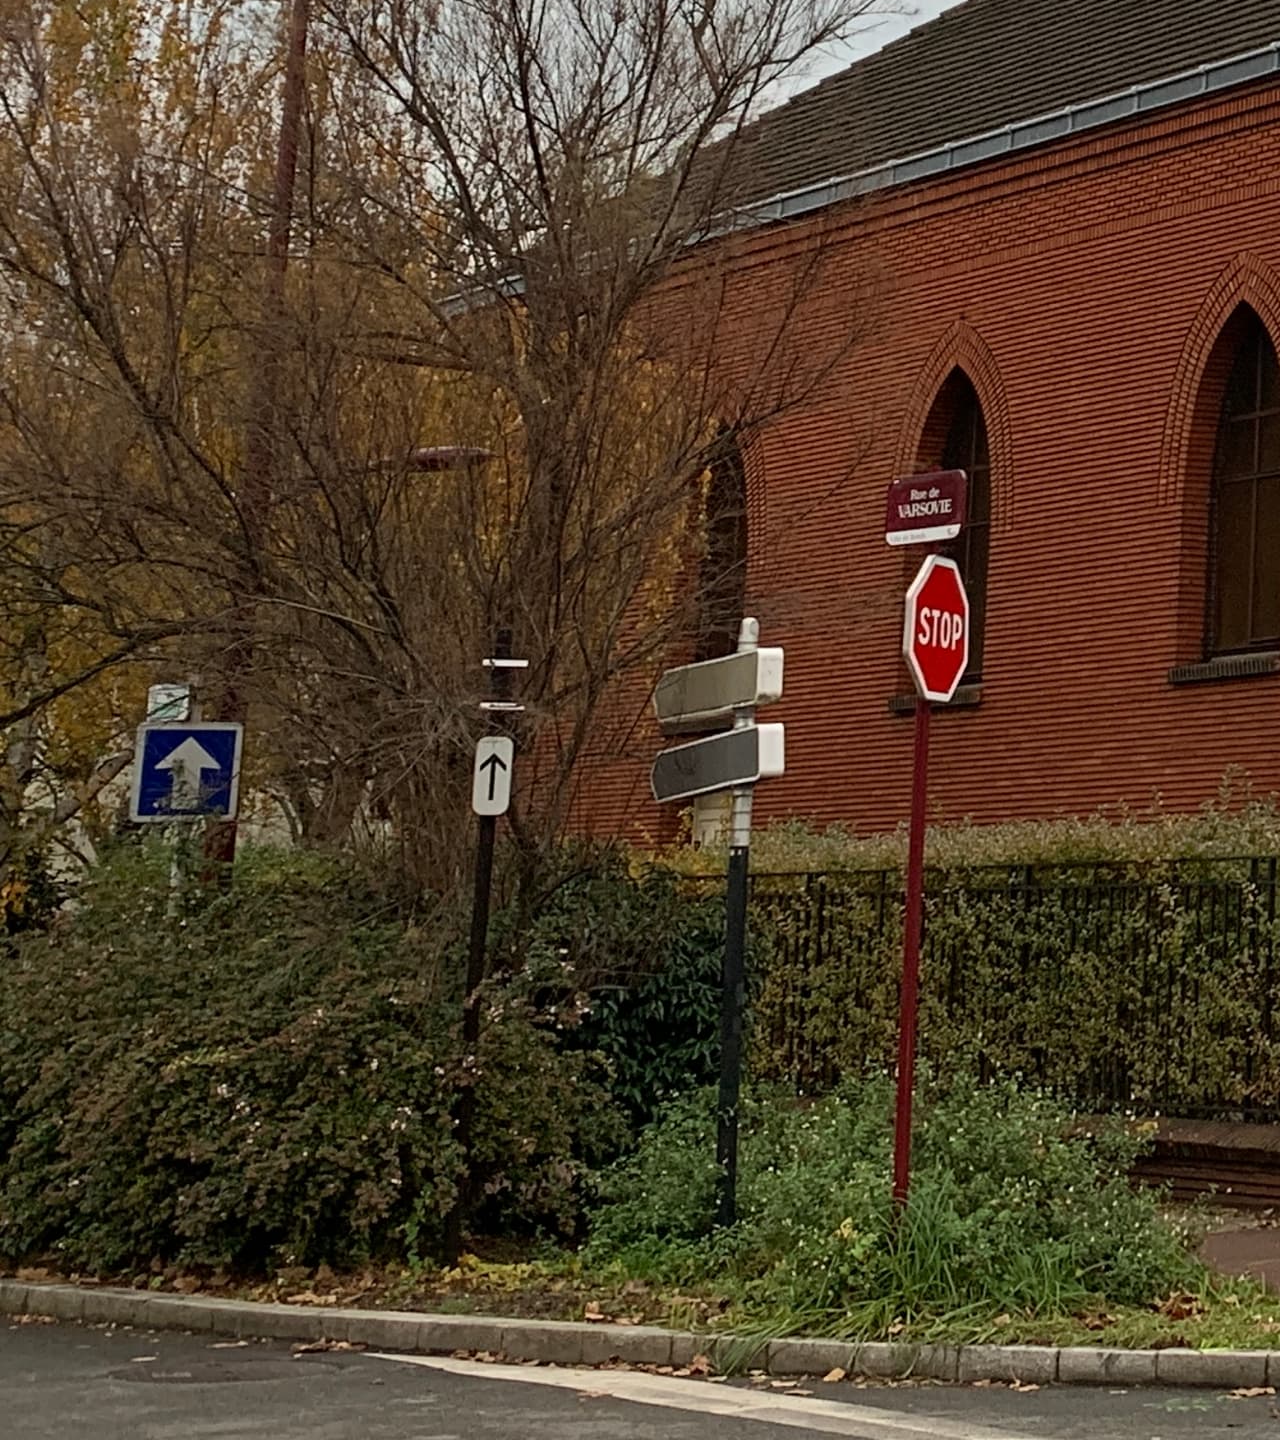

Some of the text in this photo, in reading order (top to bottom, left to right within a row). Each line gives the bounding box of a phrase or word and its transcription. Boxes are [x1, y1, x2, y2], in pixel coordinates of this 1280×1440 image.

[910, 486, 940, 501] Rue de
[898, 498, 953, 519] VARSOVIE
[918, 606, 962, 650] STOP
